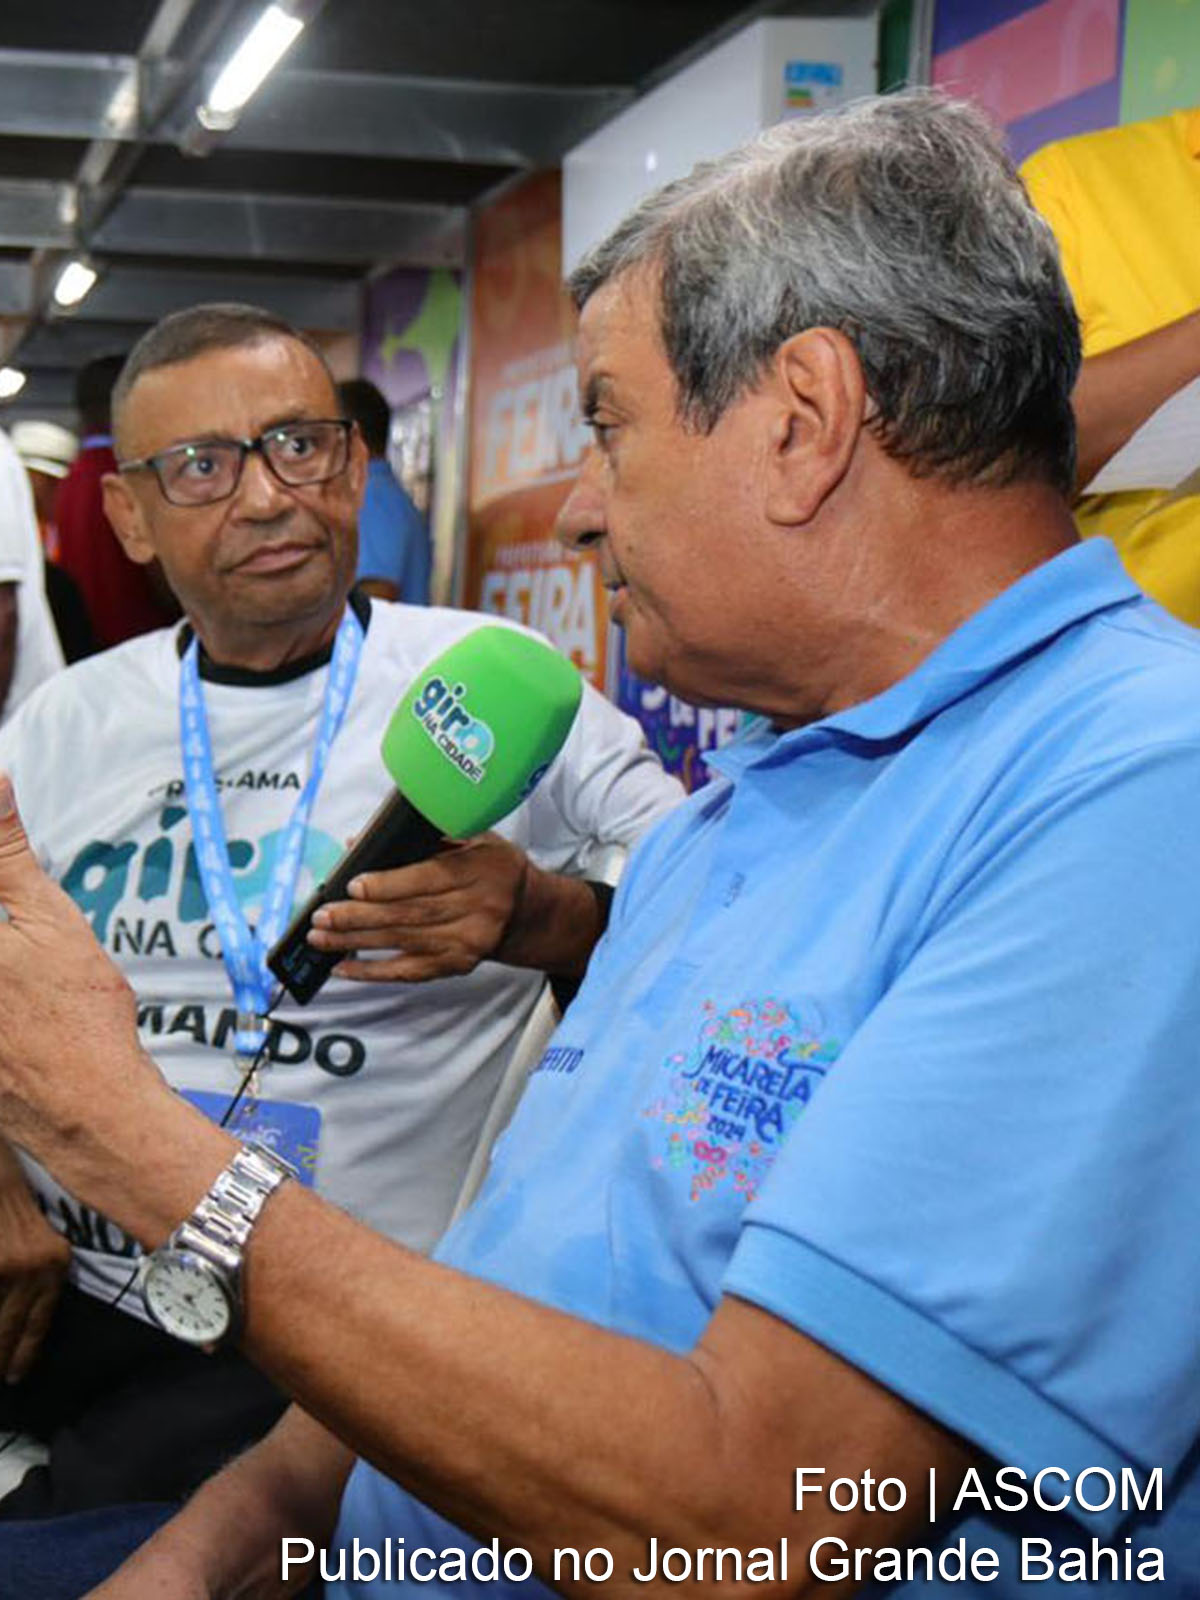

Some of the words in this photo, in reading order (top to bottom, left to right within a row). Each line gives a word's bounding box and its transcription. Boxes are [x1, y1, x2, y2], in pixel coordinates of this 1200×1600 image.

[414, 678, 492, 758] giro
[437, 732, 483, 782] CIDADE
[112, 917, 177, 957] NA
[706, 1114, 747, 1143] 2024
